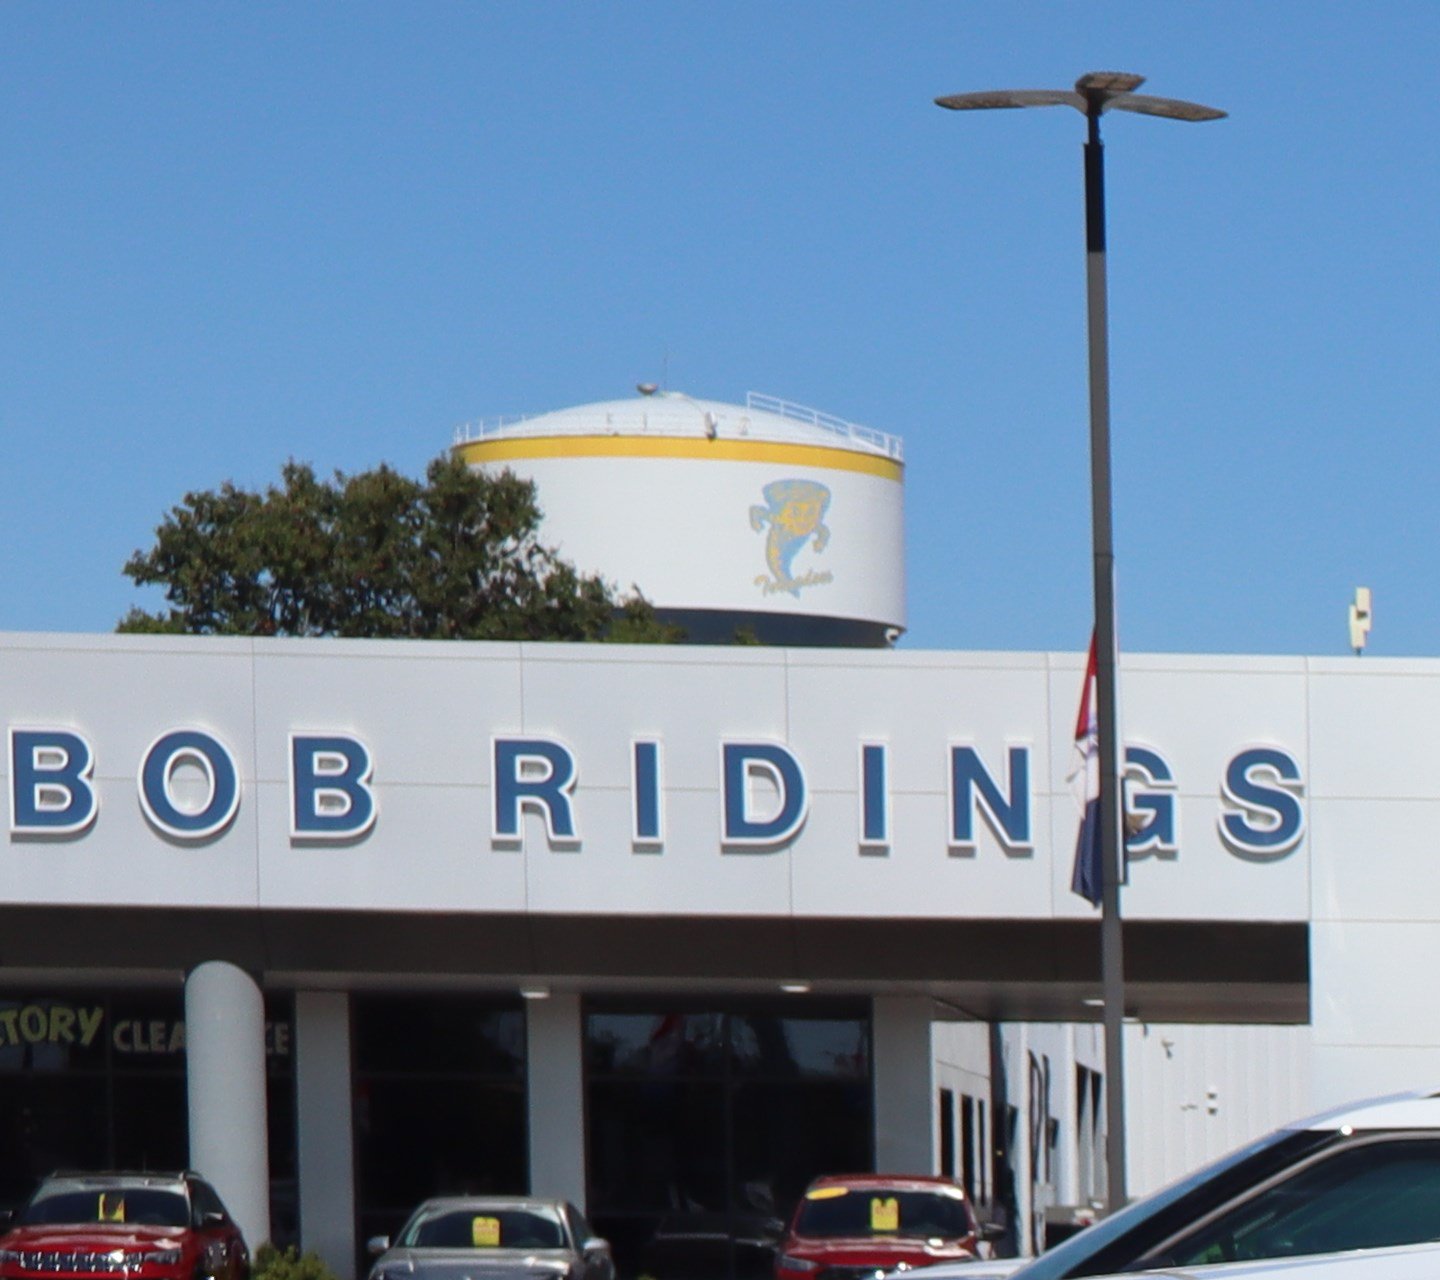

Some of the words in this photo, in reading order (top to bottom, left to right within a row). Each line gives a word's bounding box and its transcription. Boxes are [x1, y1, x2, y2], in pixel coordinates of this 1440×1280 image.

[9, 726, 377, 841] BOB
[491, 734, 1306, 854] RIDINGS
[0, 1005, 104, 1048] TORY
